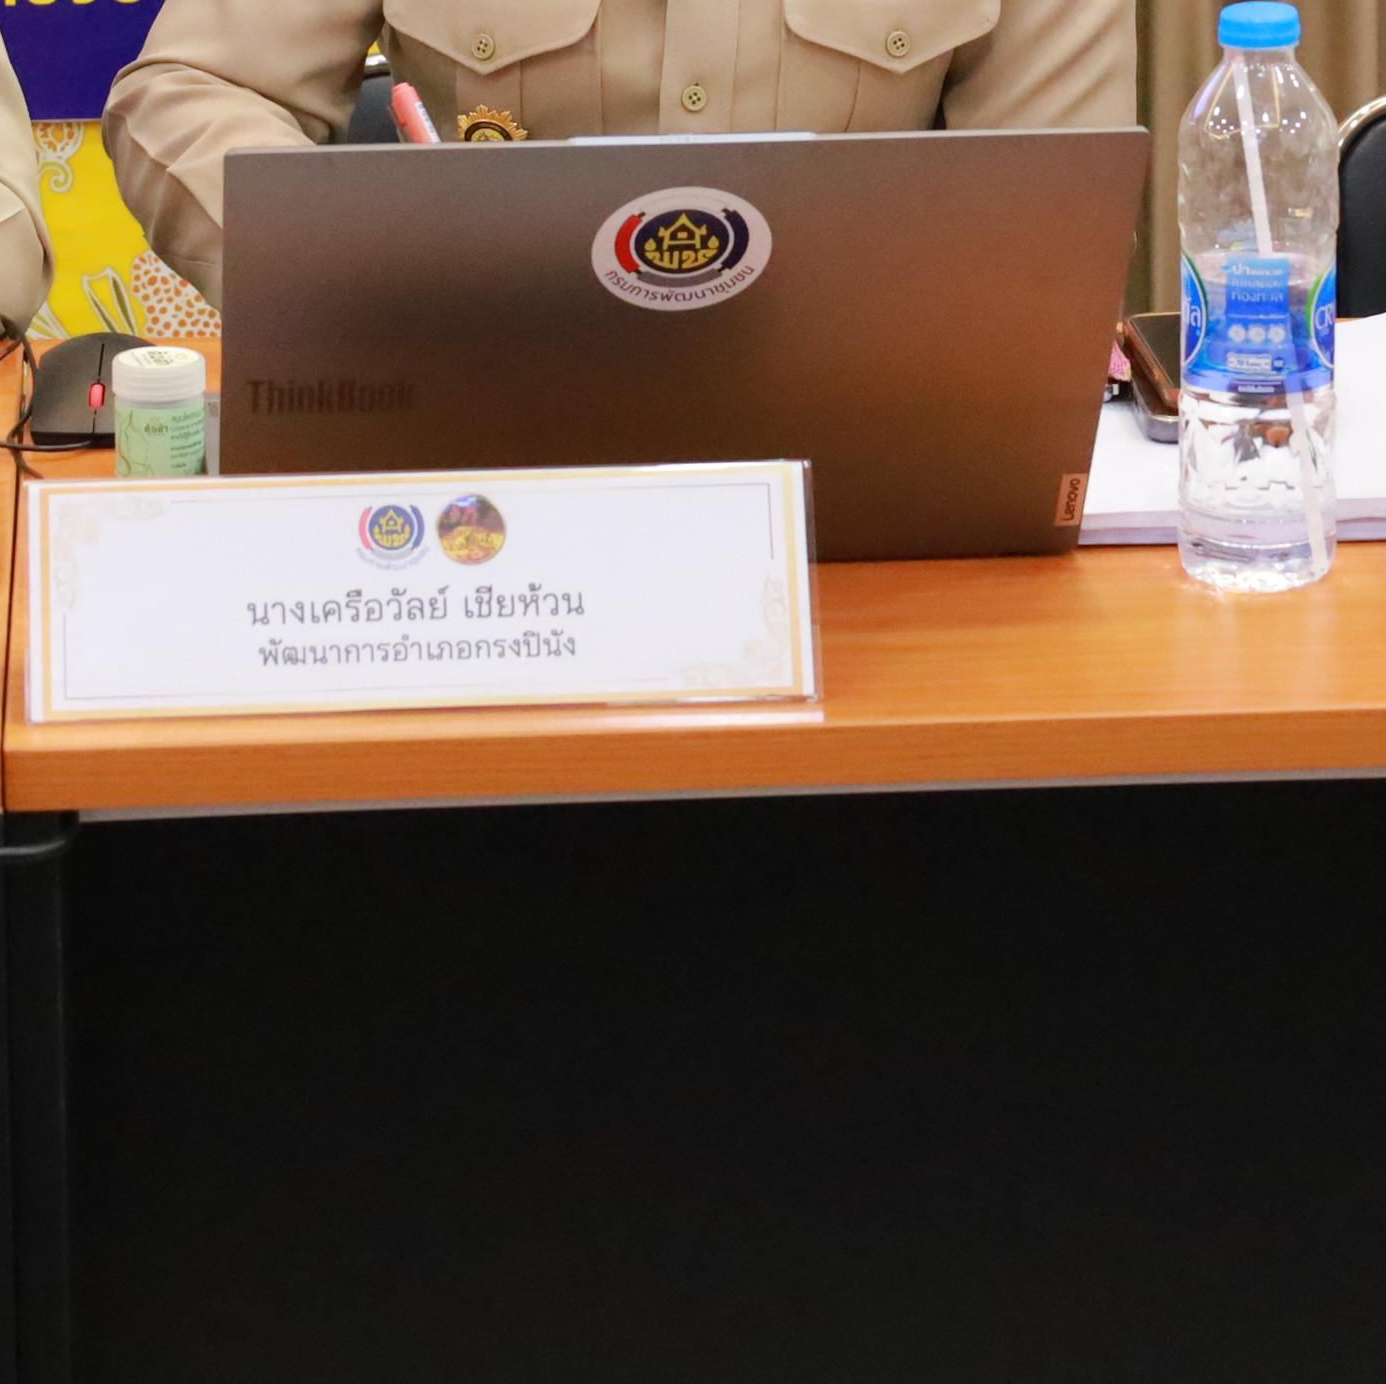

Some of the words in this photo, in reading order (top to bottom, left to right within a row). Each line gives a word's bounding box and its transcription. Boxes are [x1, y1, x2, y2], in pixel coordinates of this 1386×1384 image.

[605, 266, 755, 302] กรมการพัฒนาชุมชน
[1060, 478, 1081, 522] Lenovo
[246, 585, 449, 626] นางเครือวัลย์
[258, 628, 576, 667] พัฒนาการอำเภอกรงปินัง
